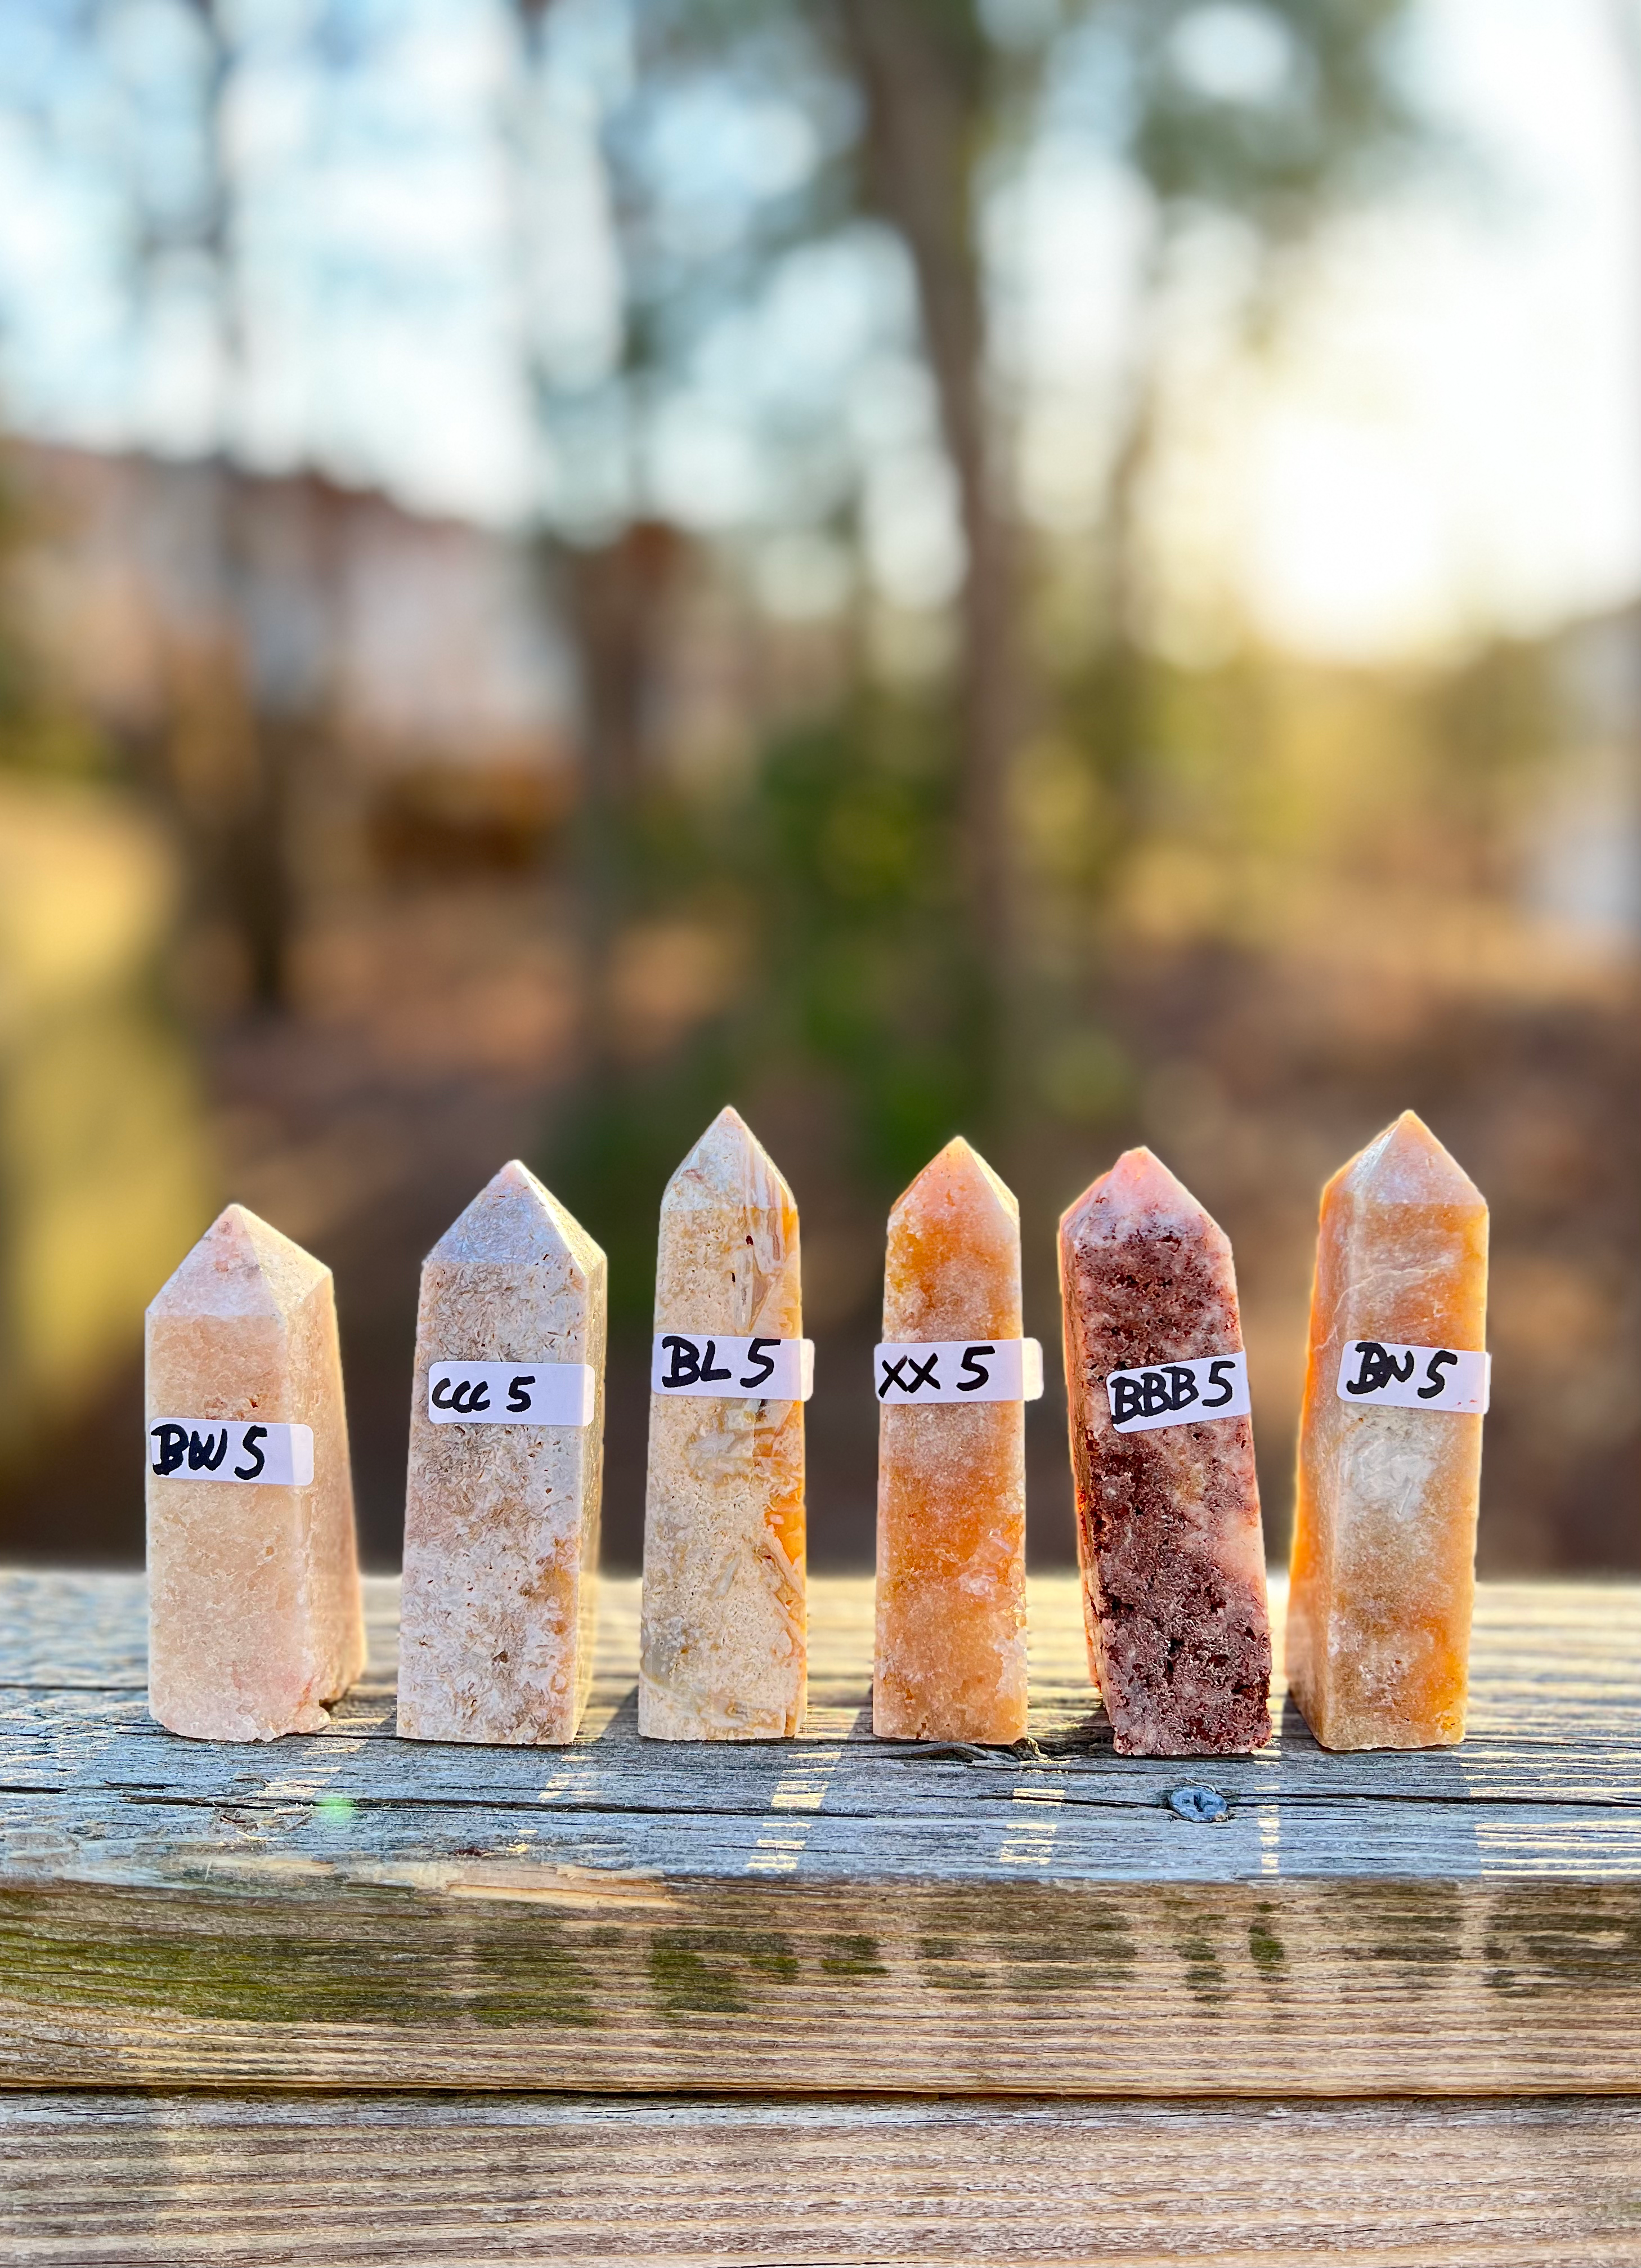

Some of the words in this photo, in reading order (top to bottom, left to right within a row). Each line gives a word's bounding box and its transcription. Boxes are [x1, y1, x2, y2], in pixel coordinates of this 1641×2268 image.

[661, 1335, 732, 1388] BL
[739, 1337, 782, 1388] 5
[878, 1353, 941, 1398] XX
[956, 1345, 996, 1392] 5
[1417, 1350, 1458, 1399] 5
[506, 1375, 536, 1413] 5
[1109, 1365, 1199, 1424] BBB
[1201, 1361, 1236, 1407] 5
[150, 1424, 228, 1476] BW
[234, 1425, 268, 1480] 5
